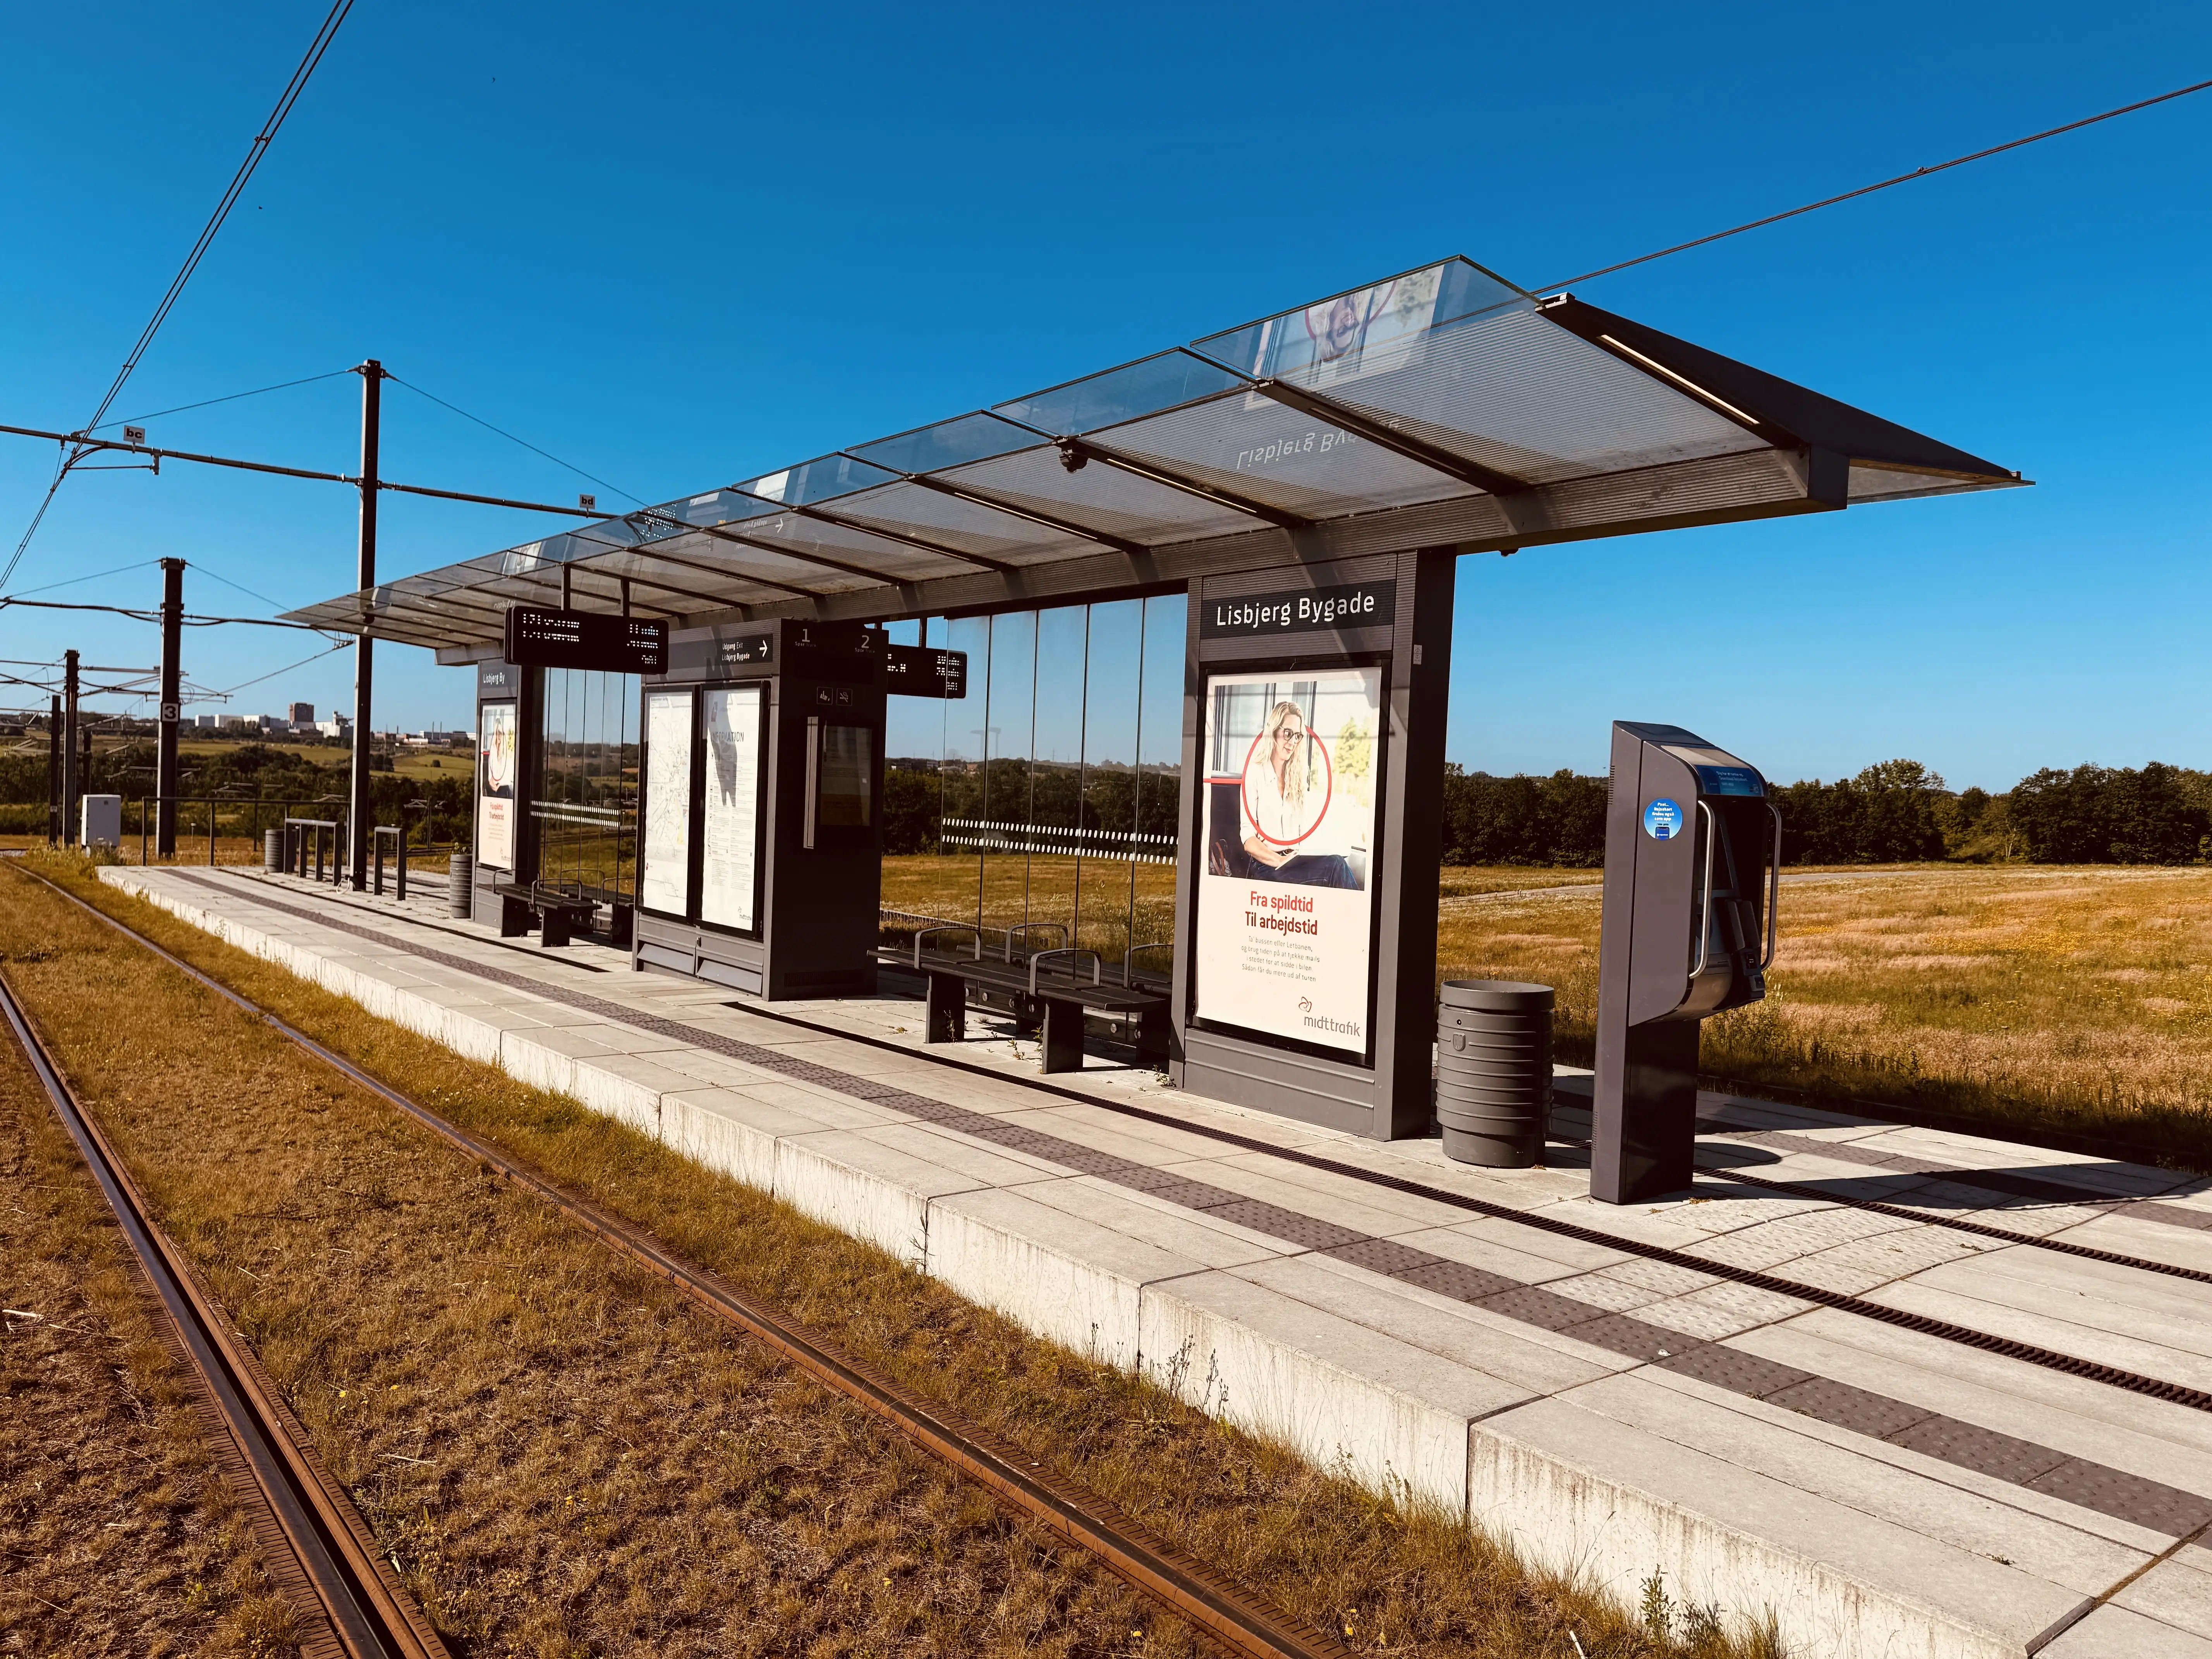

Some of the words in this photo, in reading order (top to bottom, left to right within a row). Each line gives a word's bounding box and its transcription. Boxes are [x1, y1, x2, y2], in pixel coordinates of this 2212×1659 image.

[127, 428, 142, 438] bc
[581, 496, 593, 505] bd
[1217, 602, 1291, 628] Lisbjerg
[1298, 591, 1375, 623] Bygade
[802, 629, 810, 642] 1
[861, 635, 869, 648] 2
[164, 705, 176, 719] 3
[1251, 891, 1267, 907] Fra
[1271, 894, 1313, 914] spildtid
[1245, 911, 1256, 927] Til
[1260, 914, 1317, 936] arbejdstid
[1248, 945, 1259, 955] brug
[1255, 937, 1273, 945] bussen
[1287, 941, 1312, 952] Letbanen,
[1242, 963, 1256, 972] Sådan
[1304, 1016, 1361, 1037] midttrafik
